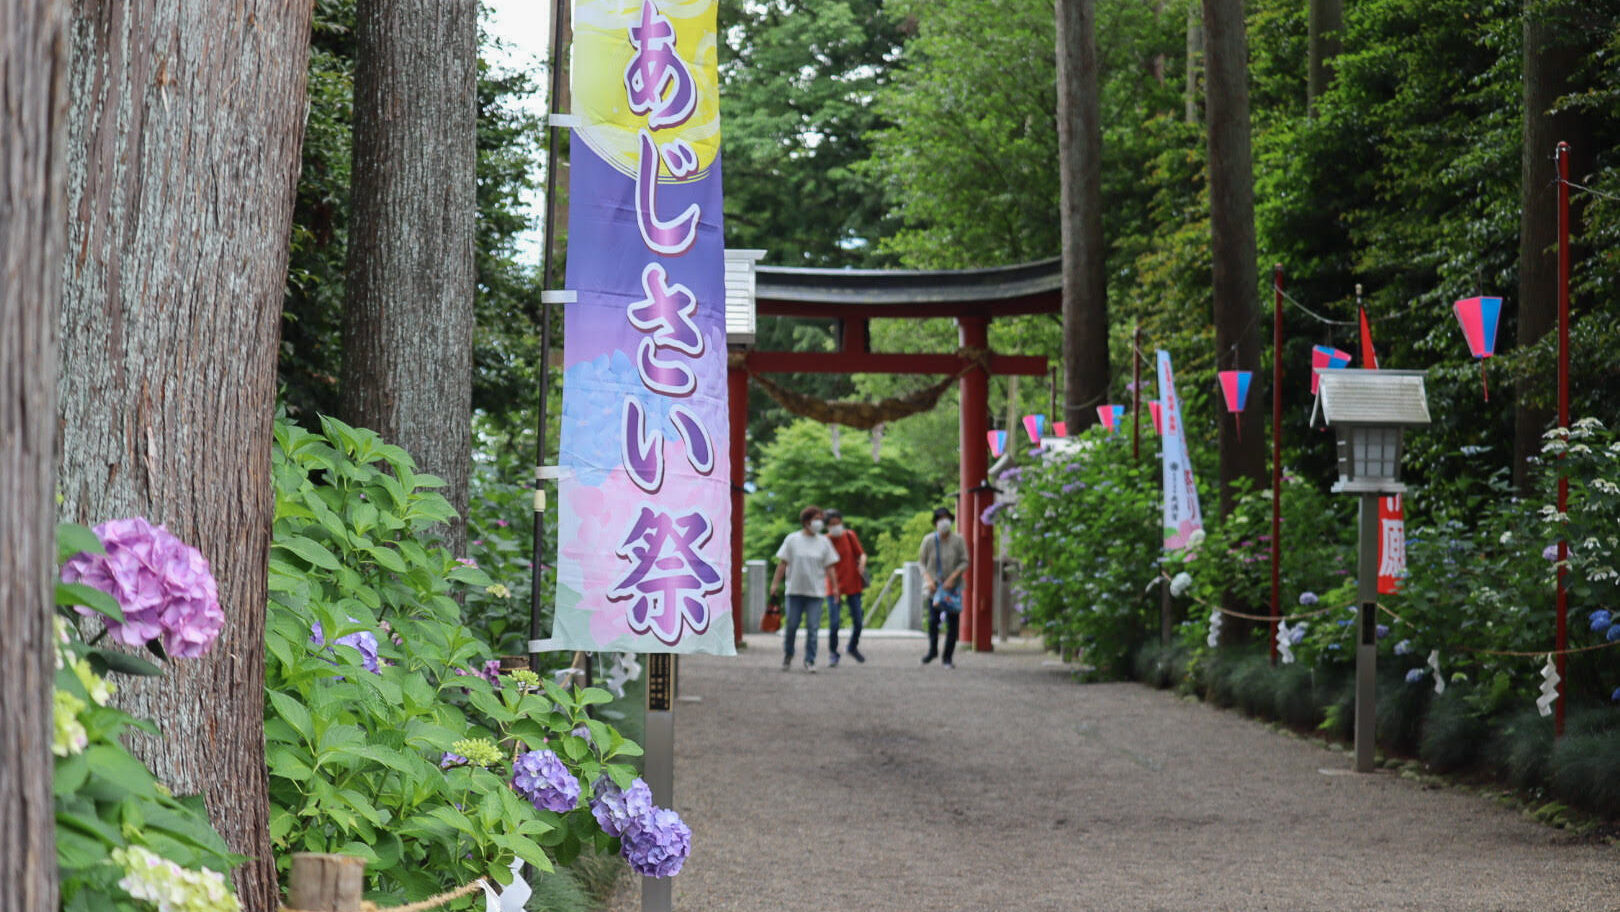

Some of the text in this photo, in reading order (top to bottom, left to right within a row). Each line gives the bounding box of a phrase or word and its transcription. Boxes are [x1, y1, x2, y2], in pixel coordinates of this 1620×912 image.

[607, 0, 724, 646] あじさい祭
